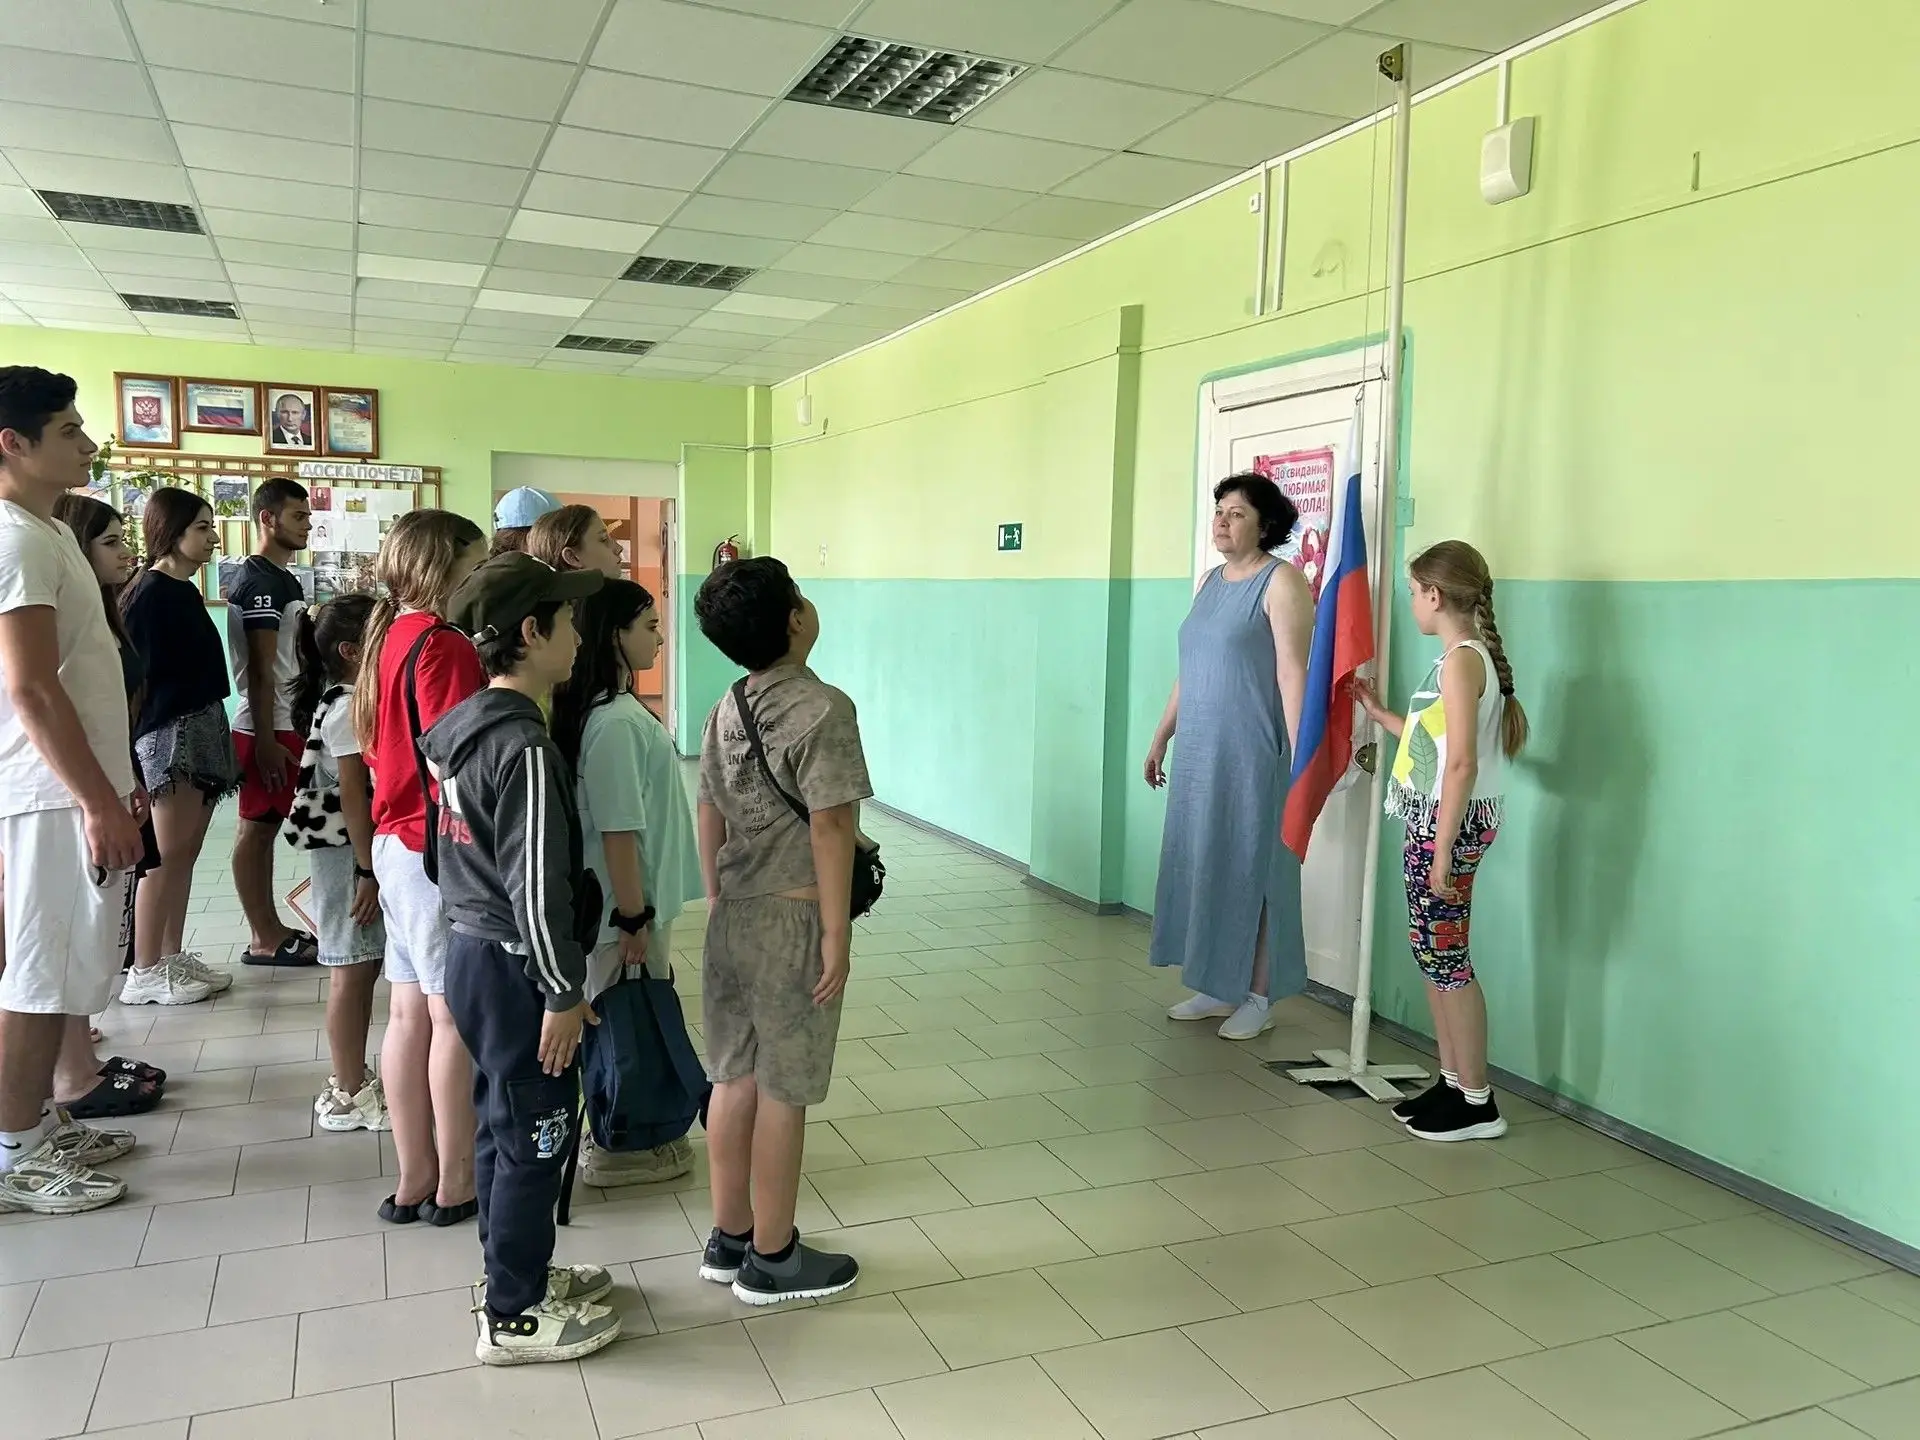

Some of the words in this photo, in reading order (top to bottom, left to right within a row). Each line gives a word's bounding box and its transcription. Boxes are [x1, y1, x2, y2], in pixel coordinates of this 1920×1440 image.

[301, 463, 355, 478] ДОСКА
[1274, 467, 1285, 482] До
[1283, 479, 1327, 497] ЛЮБИМАЯ
[254, 595, 272, 608] 33
